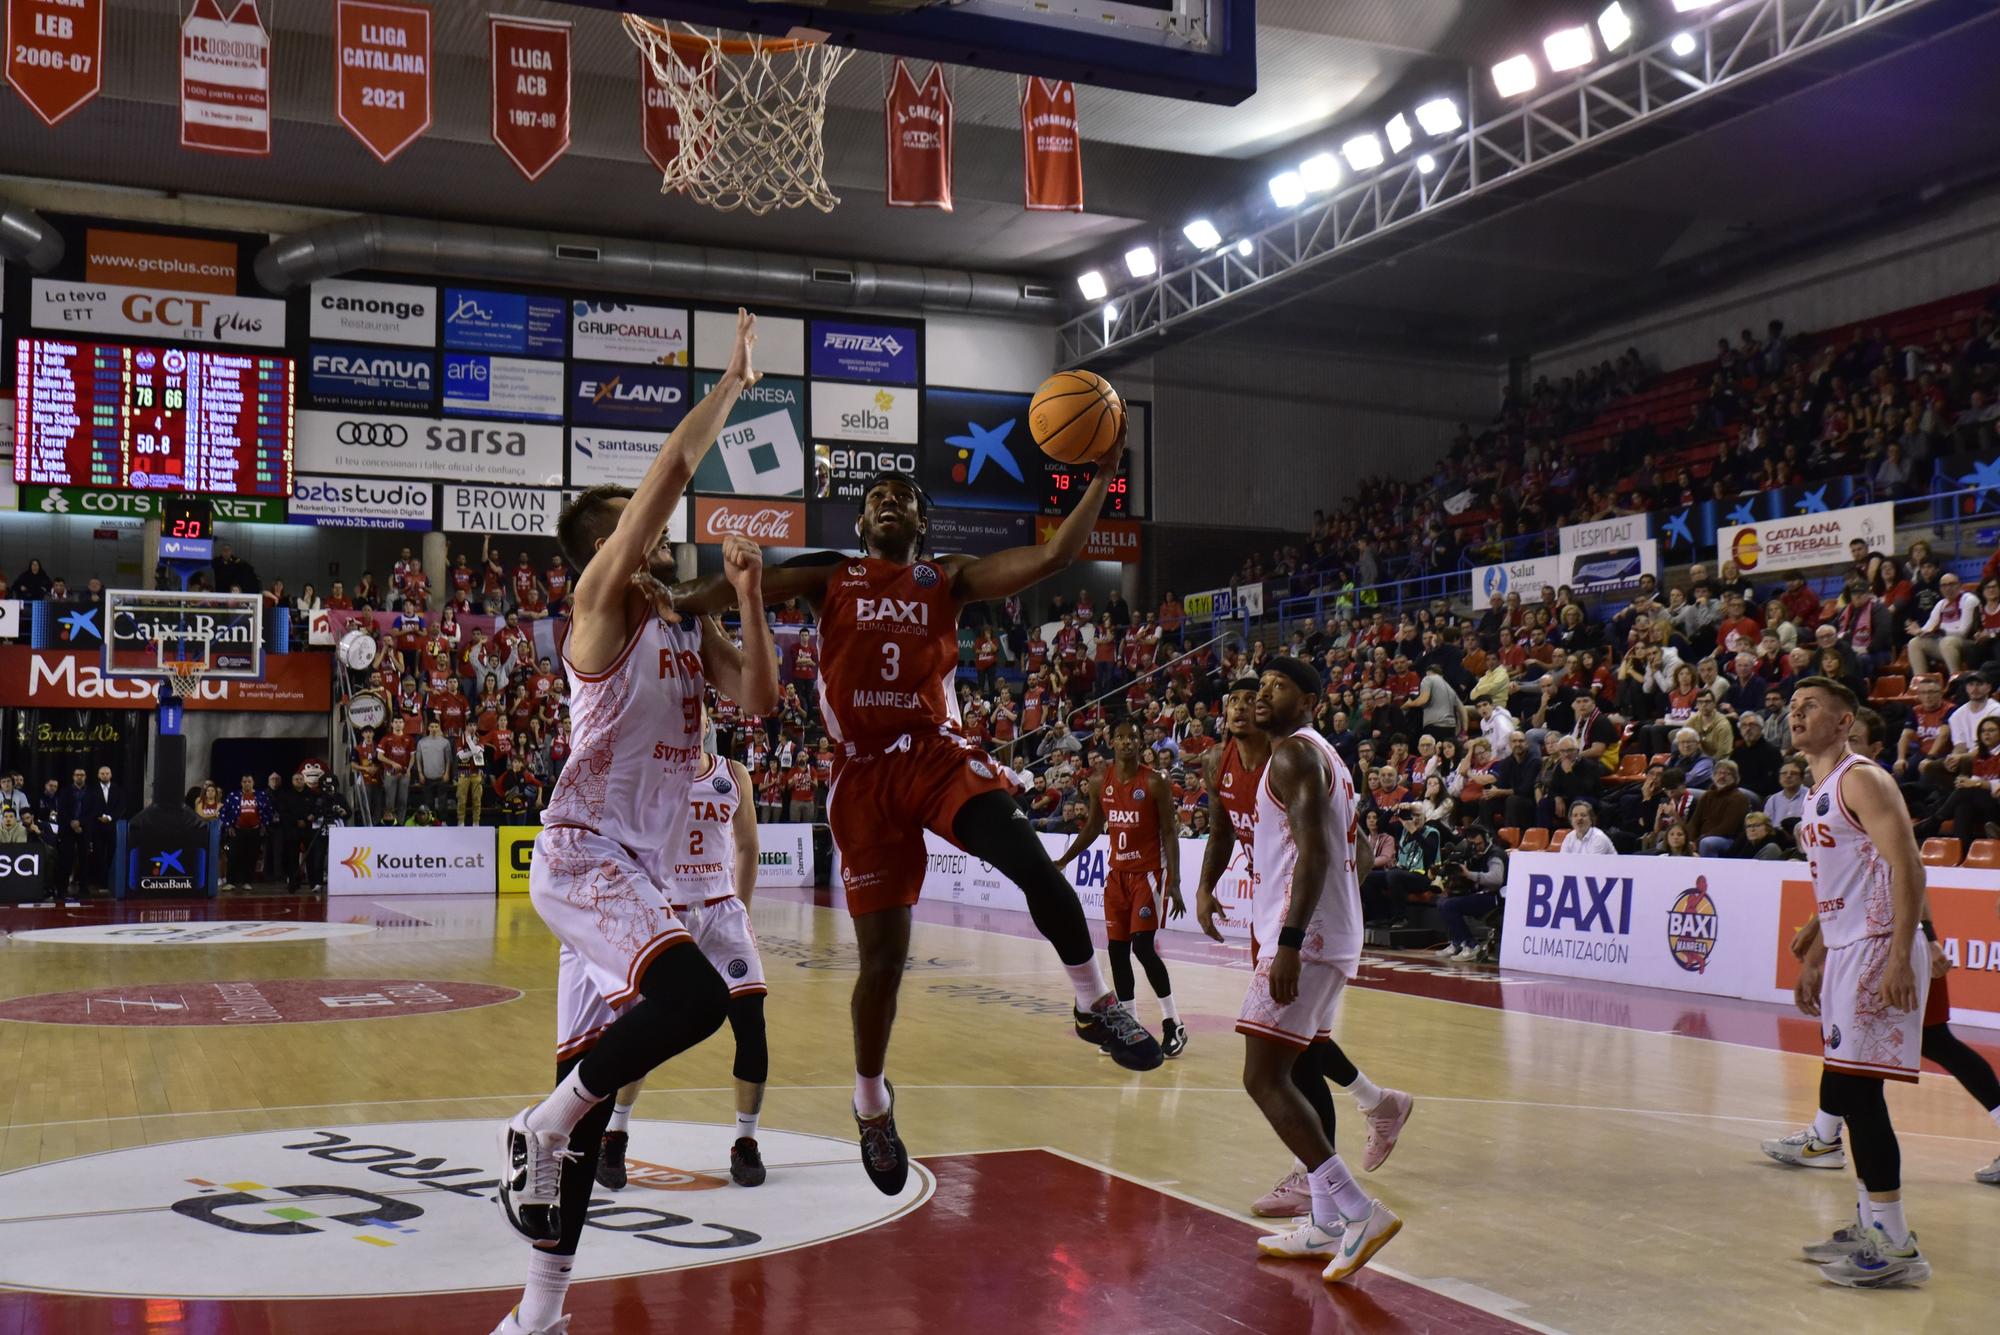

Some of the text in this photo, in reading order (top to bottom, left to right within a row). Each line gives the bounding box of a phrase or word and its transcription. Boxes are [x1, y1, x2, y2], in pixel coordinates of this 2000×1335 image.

[35, 13, 73, 39] LEB
[361, 24, 407, 48] LLIGA
[16, 45, 91, 73] 2006-07
[193, 54, 257, 69] MANRESA
[343, 47, 425, 74] CATALANA
[510, 47, 552, 71] LLIGA
[517, 75, 547, 96] ACB
[930, 86, 939, 100] 7
[361, 87, 406, 110] 2021
[509, 109, 556, 128] 1997-98
[908, 104, 944, 126] CREUS
[912, 131, 940, 142] TDK
[1037, 136, 1074, 146] RICOH
[90, 254, 235, 278] www.gctplus.com
[46, 289, 107, 303] La teva
[63, 308, 93, 322] ETT
[121, 294, 263, 340] GCT plus
[321, 296, 424, 319] canonge
[183, 329, 204, 339] ETT
[340, 317, 400, 332] Restaurant
[578, 321, 682, 341] GRUPCARULLA
[44, 341, 77, 355] Robinson
[824, 332, 883, 352] PENTEX
[41, 366, 71, 380] Harding
[313, 355, 430, 380] FRAMUN
[447, 360, 487, 381] arfe
[33, 388, 50, 400] Dani
[136, 387, 152, 406] 78
[165, 389, 182, 408] 66
[578, 375, 682, 404] EXLAND
[155, 416, 161, 430] 4
[841, 409, 889, 430] selba
[41, 436, 66, 448] Ferrari
[425, 425, 526, 456] sarsa
[722, 427, 756, 449] FUB
[335, 456, 343, 466] El
[344, 457, 360, 466] teu
[362, 458, 418, 469] concessionari
[424, 461, 446, 470] taller
[448, 462, 473, 472] oficial
[475, 463, 486, 473] de
[487, 465, 526, 476] confiança
[1044, 463, 1066, 471] LOCAL
[31, 470, 48, 482] Dani
[1051, 473, 1070, 490] 78
[838, 483, 864, 496] mini
[81, 491, 151, 512] COTS
[457, 488, 545, 511] BROWN
[1050, 495, 1122, 510] 4 5
[296, 504, 336, 514] Marketing
[341, 506, 398, 515] Transformació
[400, 507, 424, 517] Digital
[317, 517, 404, 530] www.b2b.studio
[457, 511, 544, 532] TAILOR
[706, 506, 794, 539] Coca-Cola
[931, 523, 957, 532] TOYOTA
[1766, 521, 1840, 541] CATALANA
[1087, 531, 1137, 547] RELLA
[1766, 535, 1841, 555] DE TREBALL
[1510, 564, 1535, 579] Salut
[856, 597, 929, 626] BAXI
[880, 642, 900, 682] 3
[256, 681, 278, 690] coding
[247, 691, 304, 700] marking solutions
[853, 689, 922, 709] MANRESA
[38, 722, 86, 741] Bruixa
[690, 801, 731, 823] TAS
[1108, 810, 1139, 823] BAXI
[689, 830, 704, 855] 2
[1118, 832, 1127, 850] 0
[1801, 822, 1836, 848] TAS
[377, 853, 484, 869] Kouten.cat
[674, 862, 723, 874] VYTURYS
[758, 852, 788, 865] TECT
[141, 879, 192, 889] CaixaBank
[1525, 874, 1634, 935] BAXI
[1669, 912, 1717, 938] BAXI
[1522, 935, 1629, 965] CLIMATIZACIÓN
[1675, 938, 1708, 955] MANRESA
